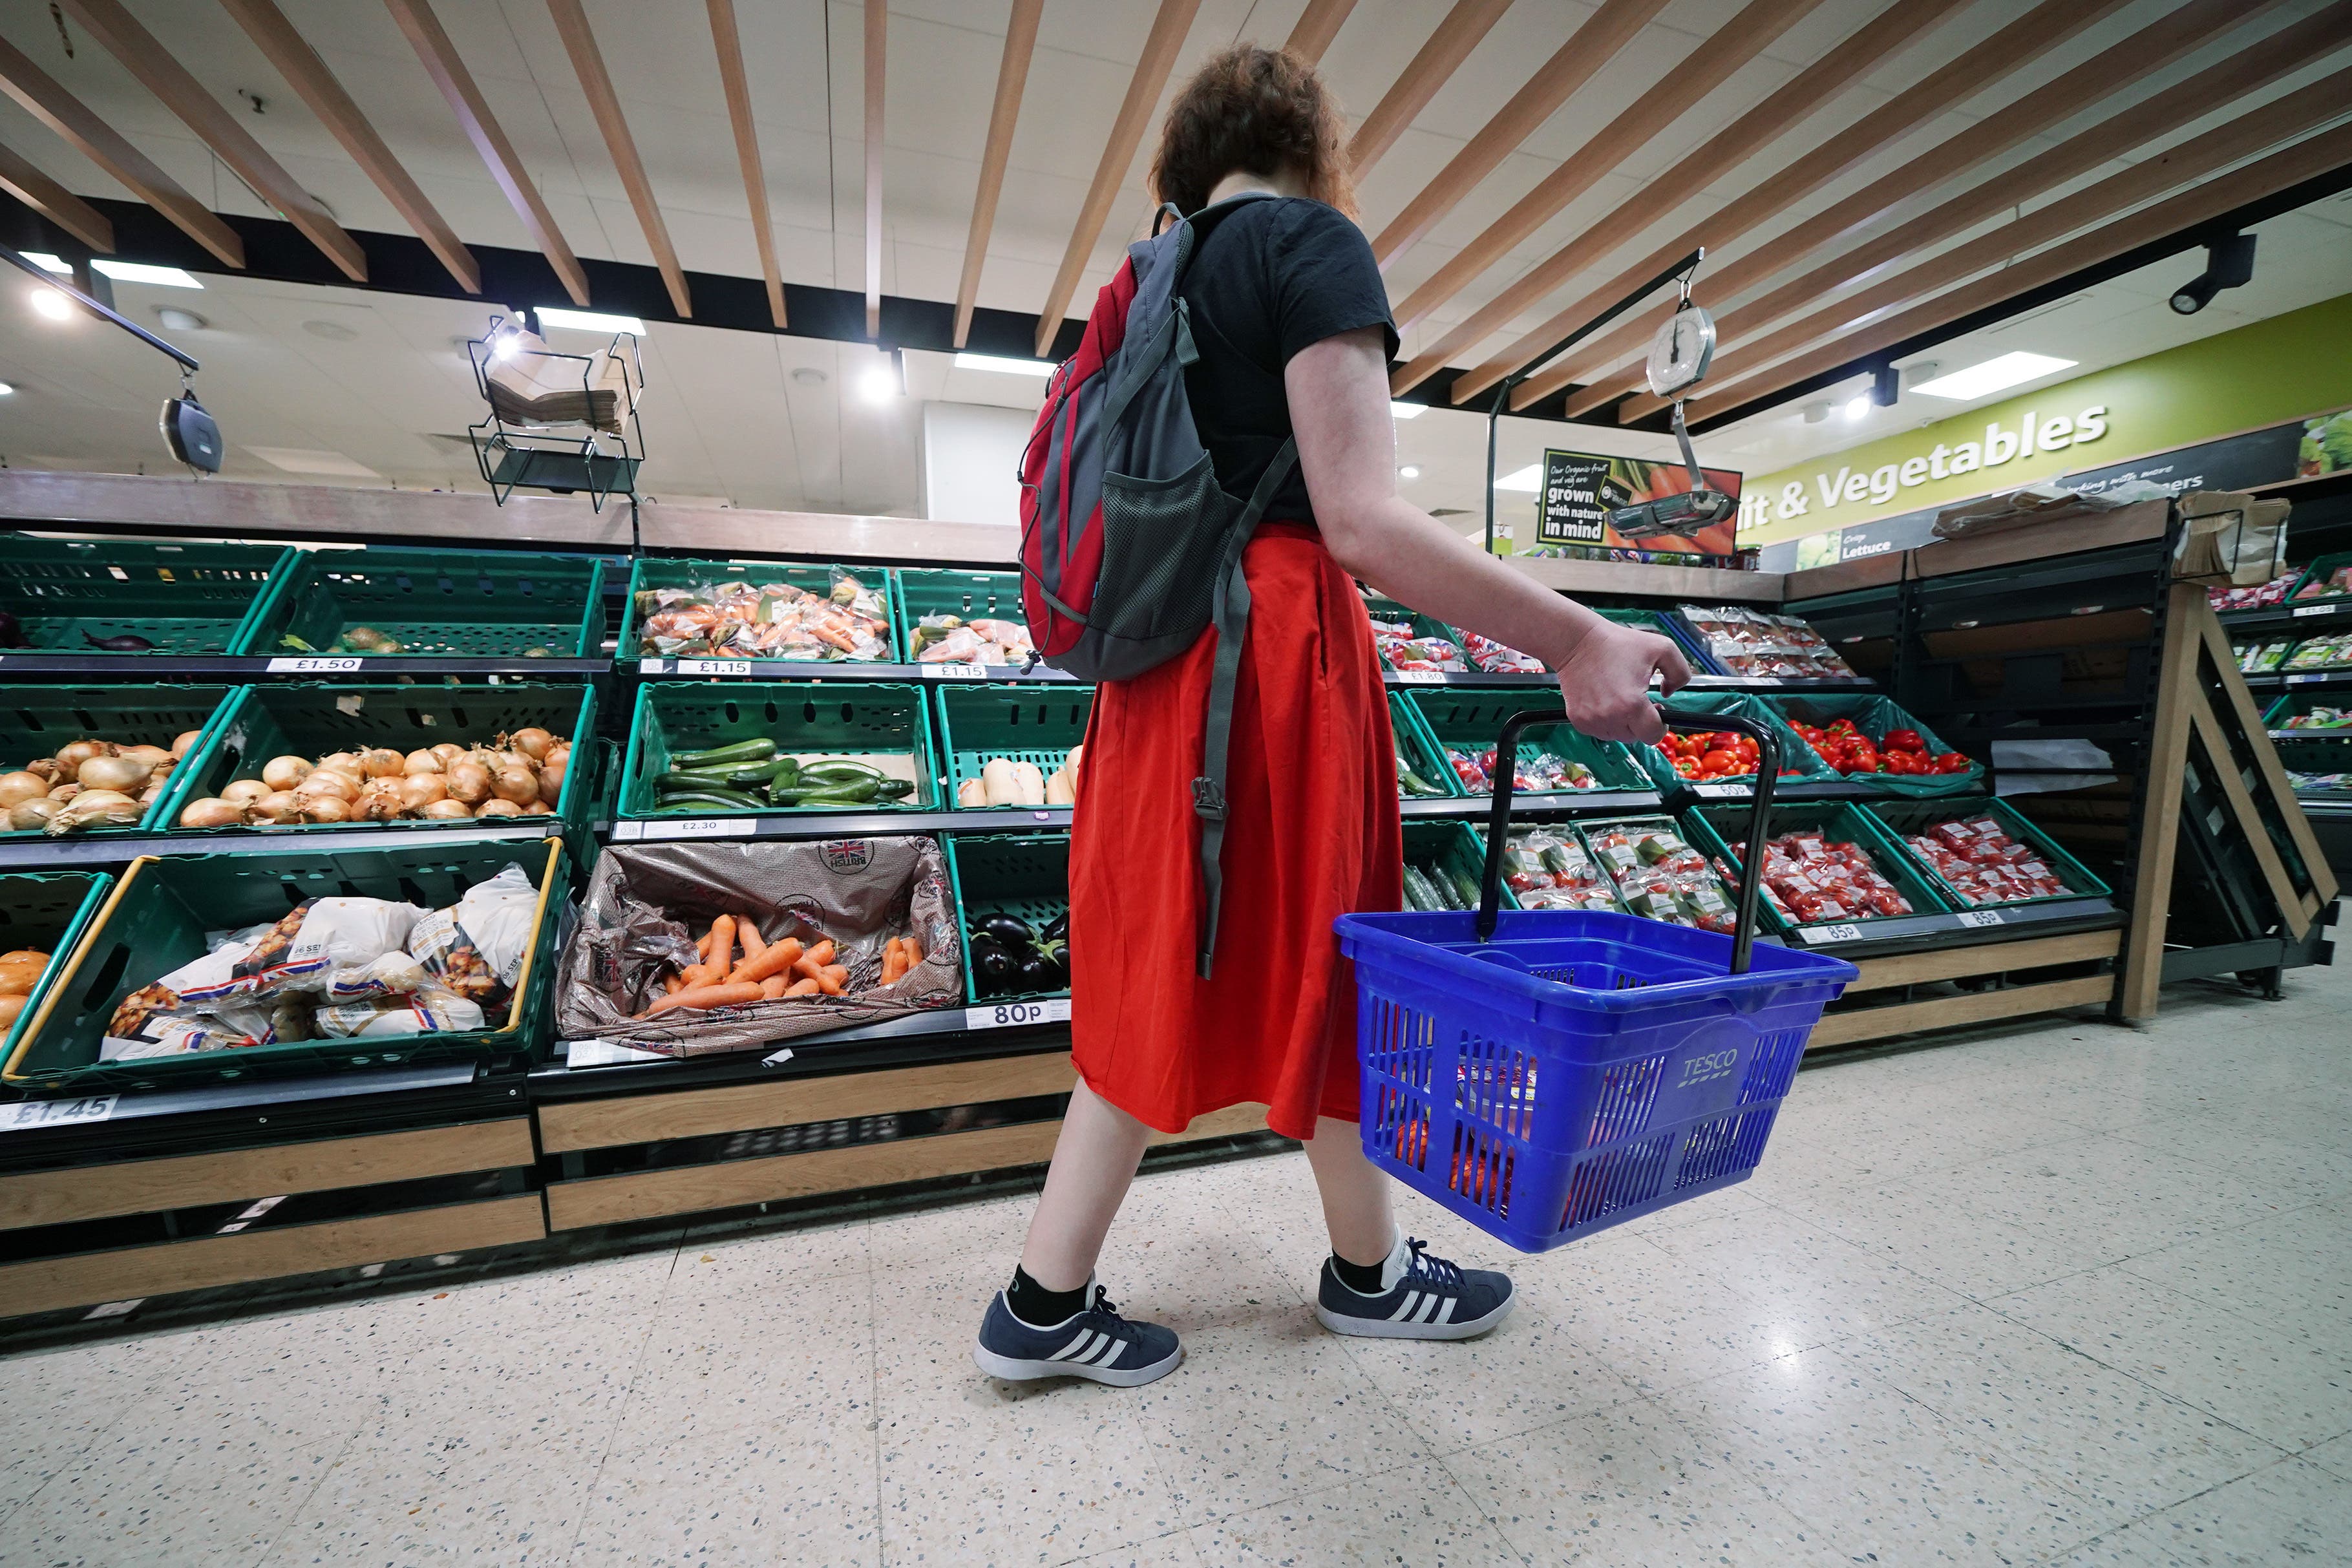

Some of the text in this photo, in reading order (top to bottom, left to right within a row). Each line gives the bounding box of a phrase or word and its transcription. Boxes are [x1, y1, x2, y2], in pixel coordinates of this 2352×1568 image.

[1551, 463, 1608, 477] Our Organic fruit
[1735, 406, 2108, 532] it & Vegetables
[1551, 476, 1564, 485] and
[1564, 476, 1574, 489] veg
[2067, 465, 2174, 494] orking with more
[1547, 487, 1594, 504] grown
[1547, 504, 1603, 520] with nature
[1545, 516, 1603, 540] in mind
[1842, 540, 1892, 560] Lettuce
[295, 659, 355, 670] £1.50
[699, 661, 747, 673] £1.15
[941, 666, 982, 677] £1.15
[1412, 672, 1442, 681] £1.80
[1720, 785, 1746, 796] 60p
[683, 821, 717, 830] £2.30
[831, 856, 866, 868] BRITISH
[1972, 912, 1997, 925] 85p
[1827, 925, 1855, 938] 85p
[502, 958, 519, 980] 06 SEP
[995, 1004, 1041, 1024] 80p
[1684, 1048, 1738, 1077] TESCO
[13, 1097, 111, 1125] £1.45
